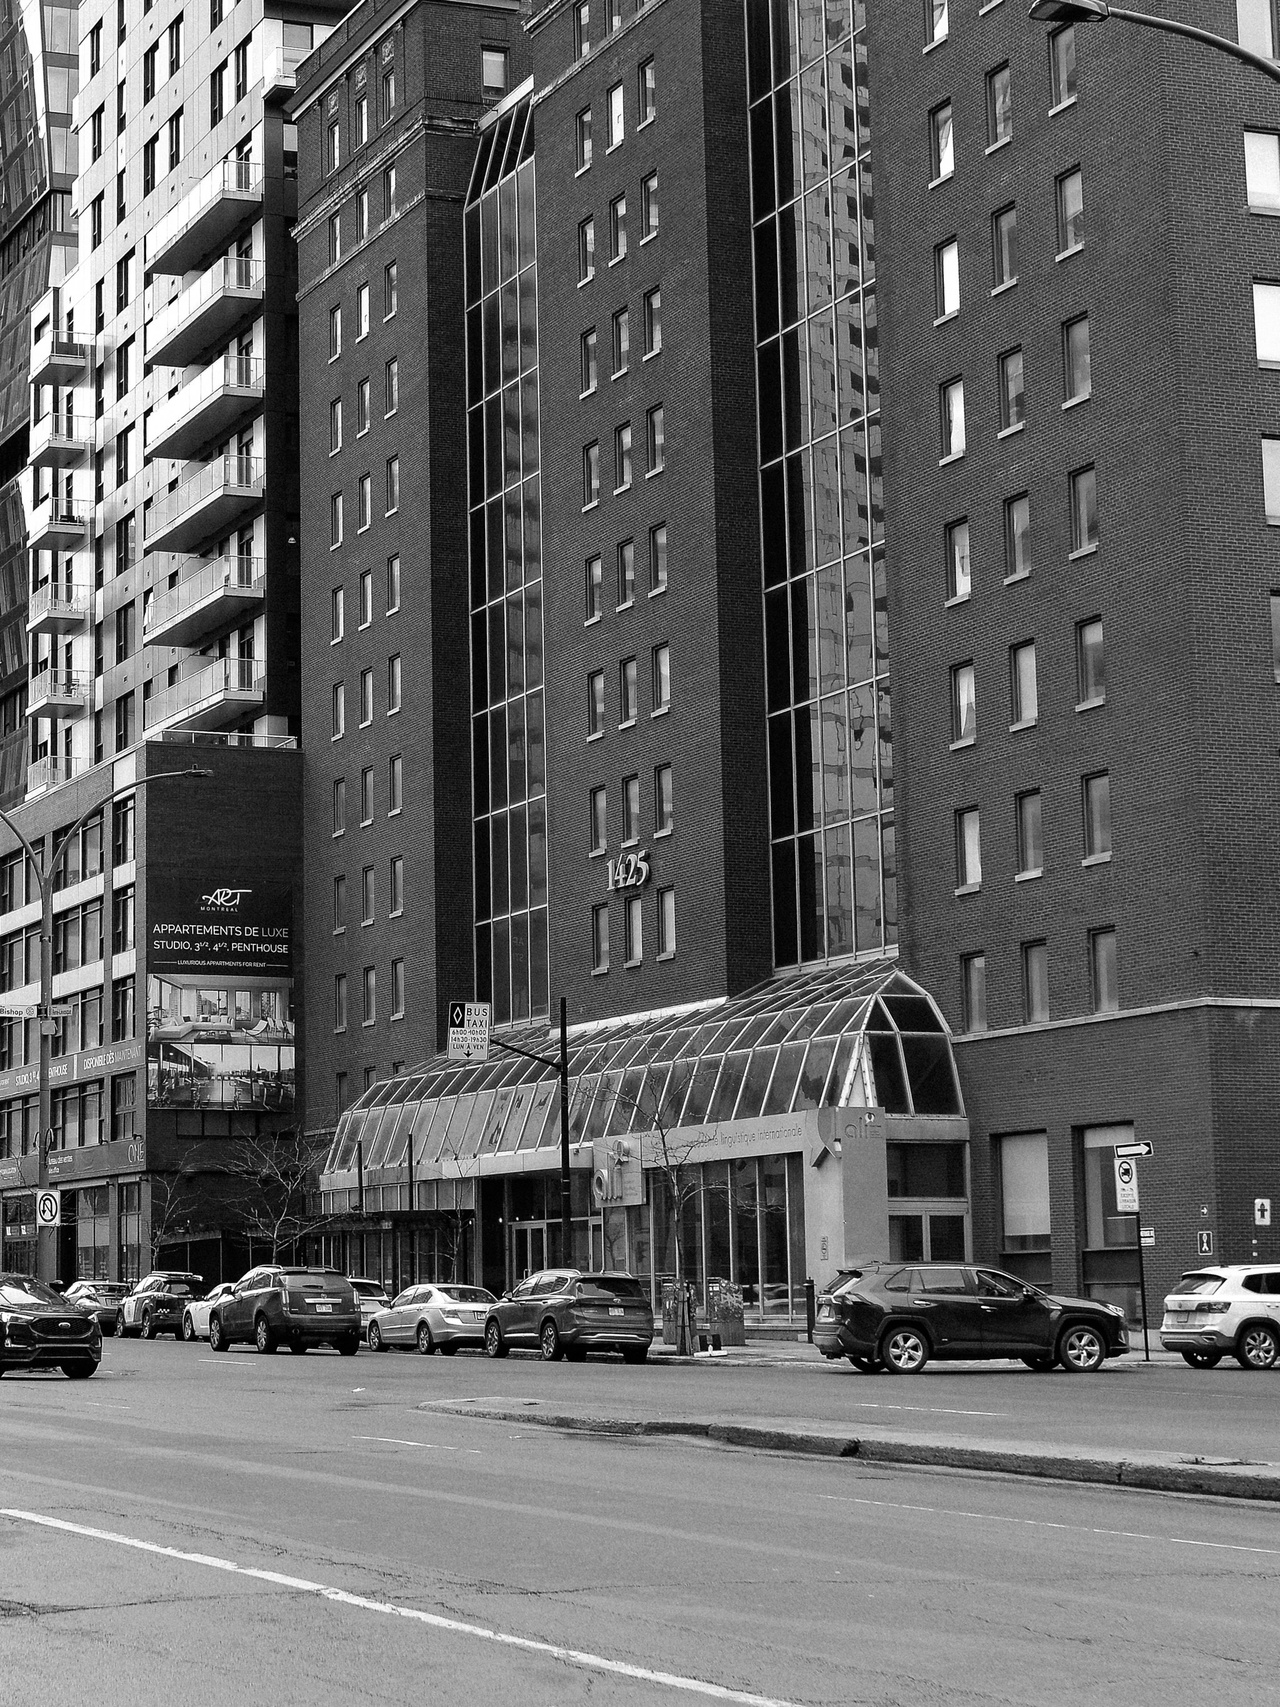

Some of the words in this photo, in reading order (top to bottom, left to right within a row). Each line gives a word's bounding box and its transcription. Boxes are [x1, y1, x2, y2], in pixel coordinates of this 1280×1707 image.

[606, 850, 649, 890] 1425
[201, 888, 252, 906] ART
[153, 923, 242, 936] APPARTEMENTS
[244, 926, 260, 937] DE
[261, 927, 289, 938] LUXE
[231, 943, 289, 954] PENTHOUSE
[0, 1007, 24, 1016] Bishop
[466, 1007, 488, 1017] BUS
[467, 1019, 488, 1028] TAXI
[49, 1064, 68, 1078] ENTHOUSE
